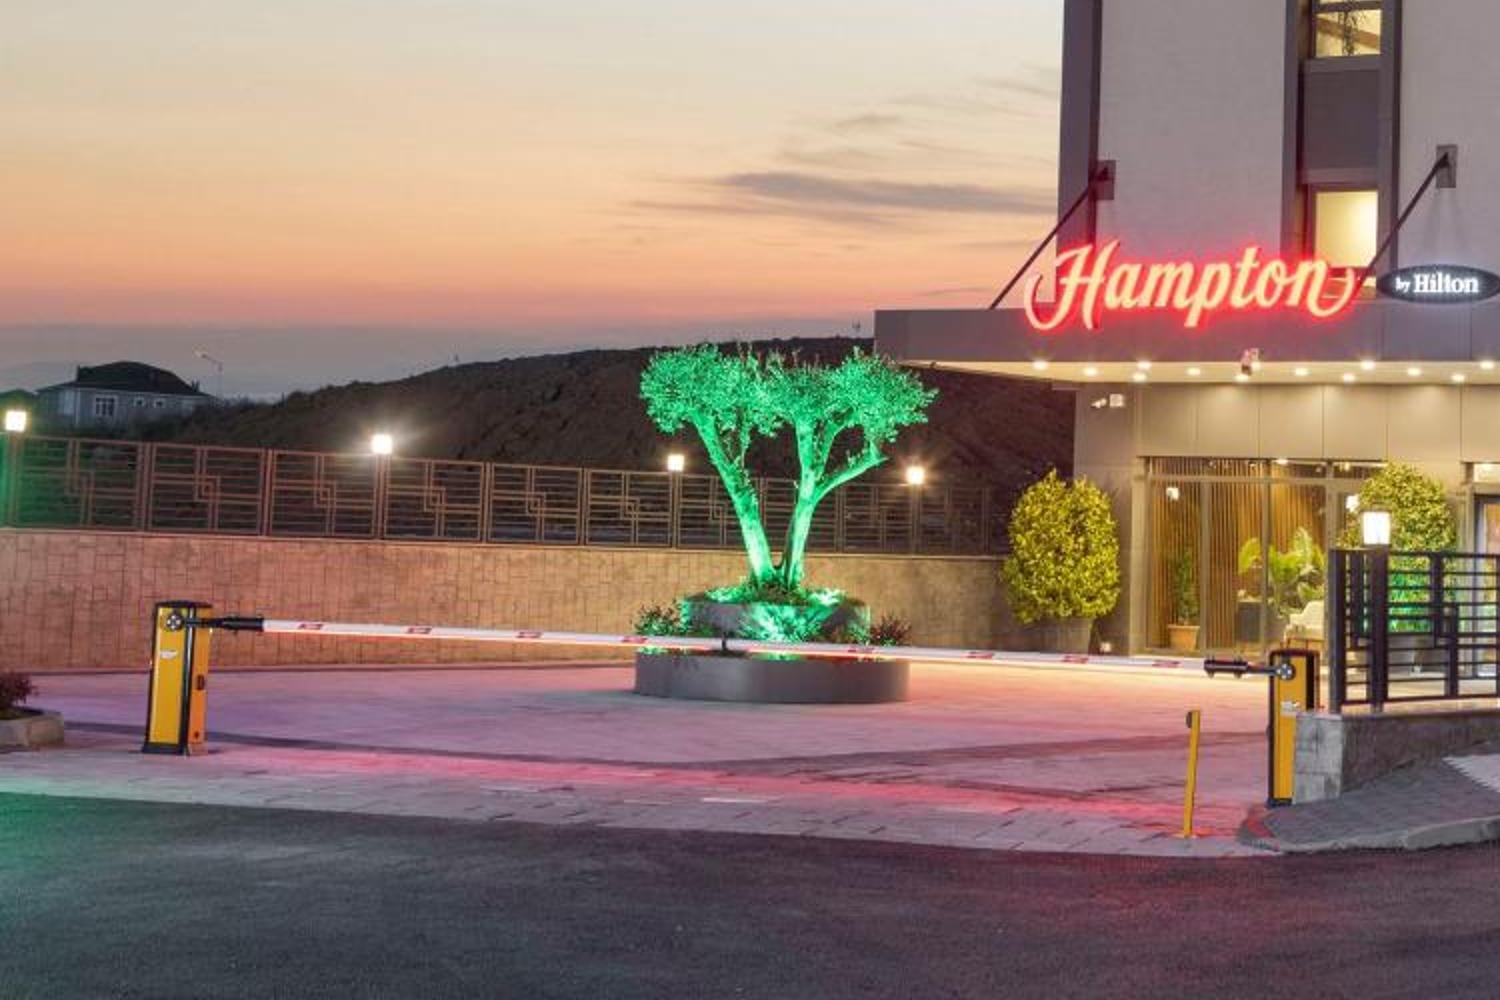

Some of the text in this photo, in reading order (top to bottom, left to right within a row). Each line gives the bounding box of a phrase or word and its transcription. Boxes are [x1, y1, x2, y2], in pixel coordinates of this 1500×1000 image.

[1023, 239, 1355, 331] Hampton
[1395, 271, 1480, 293] by Hilton
